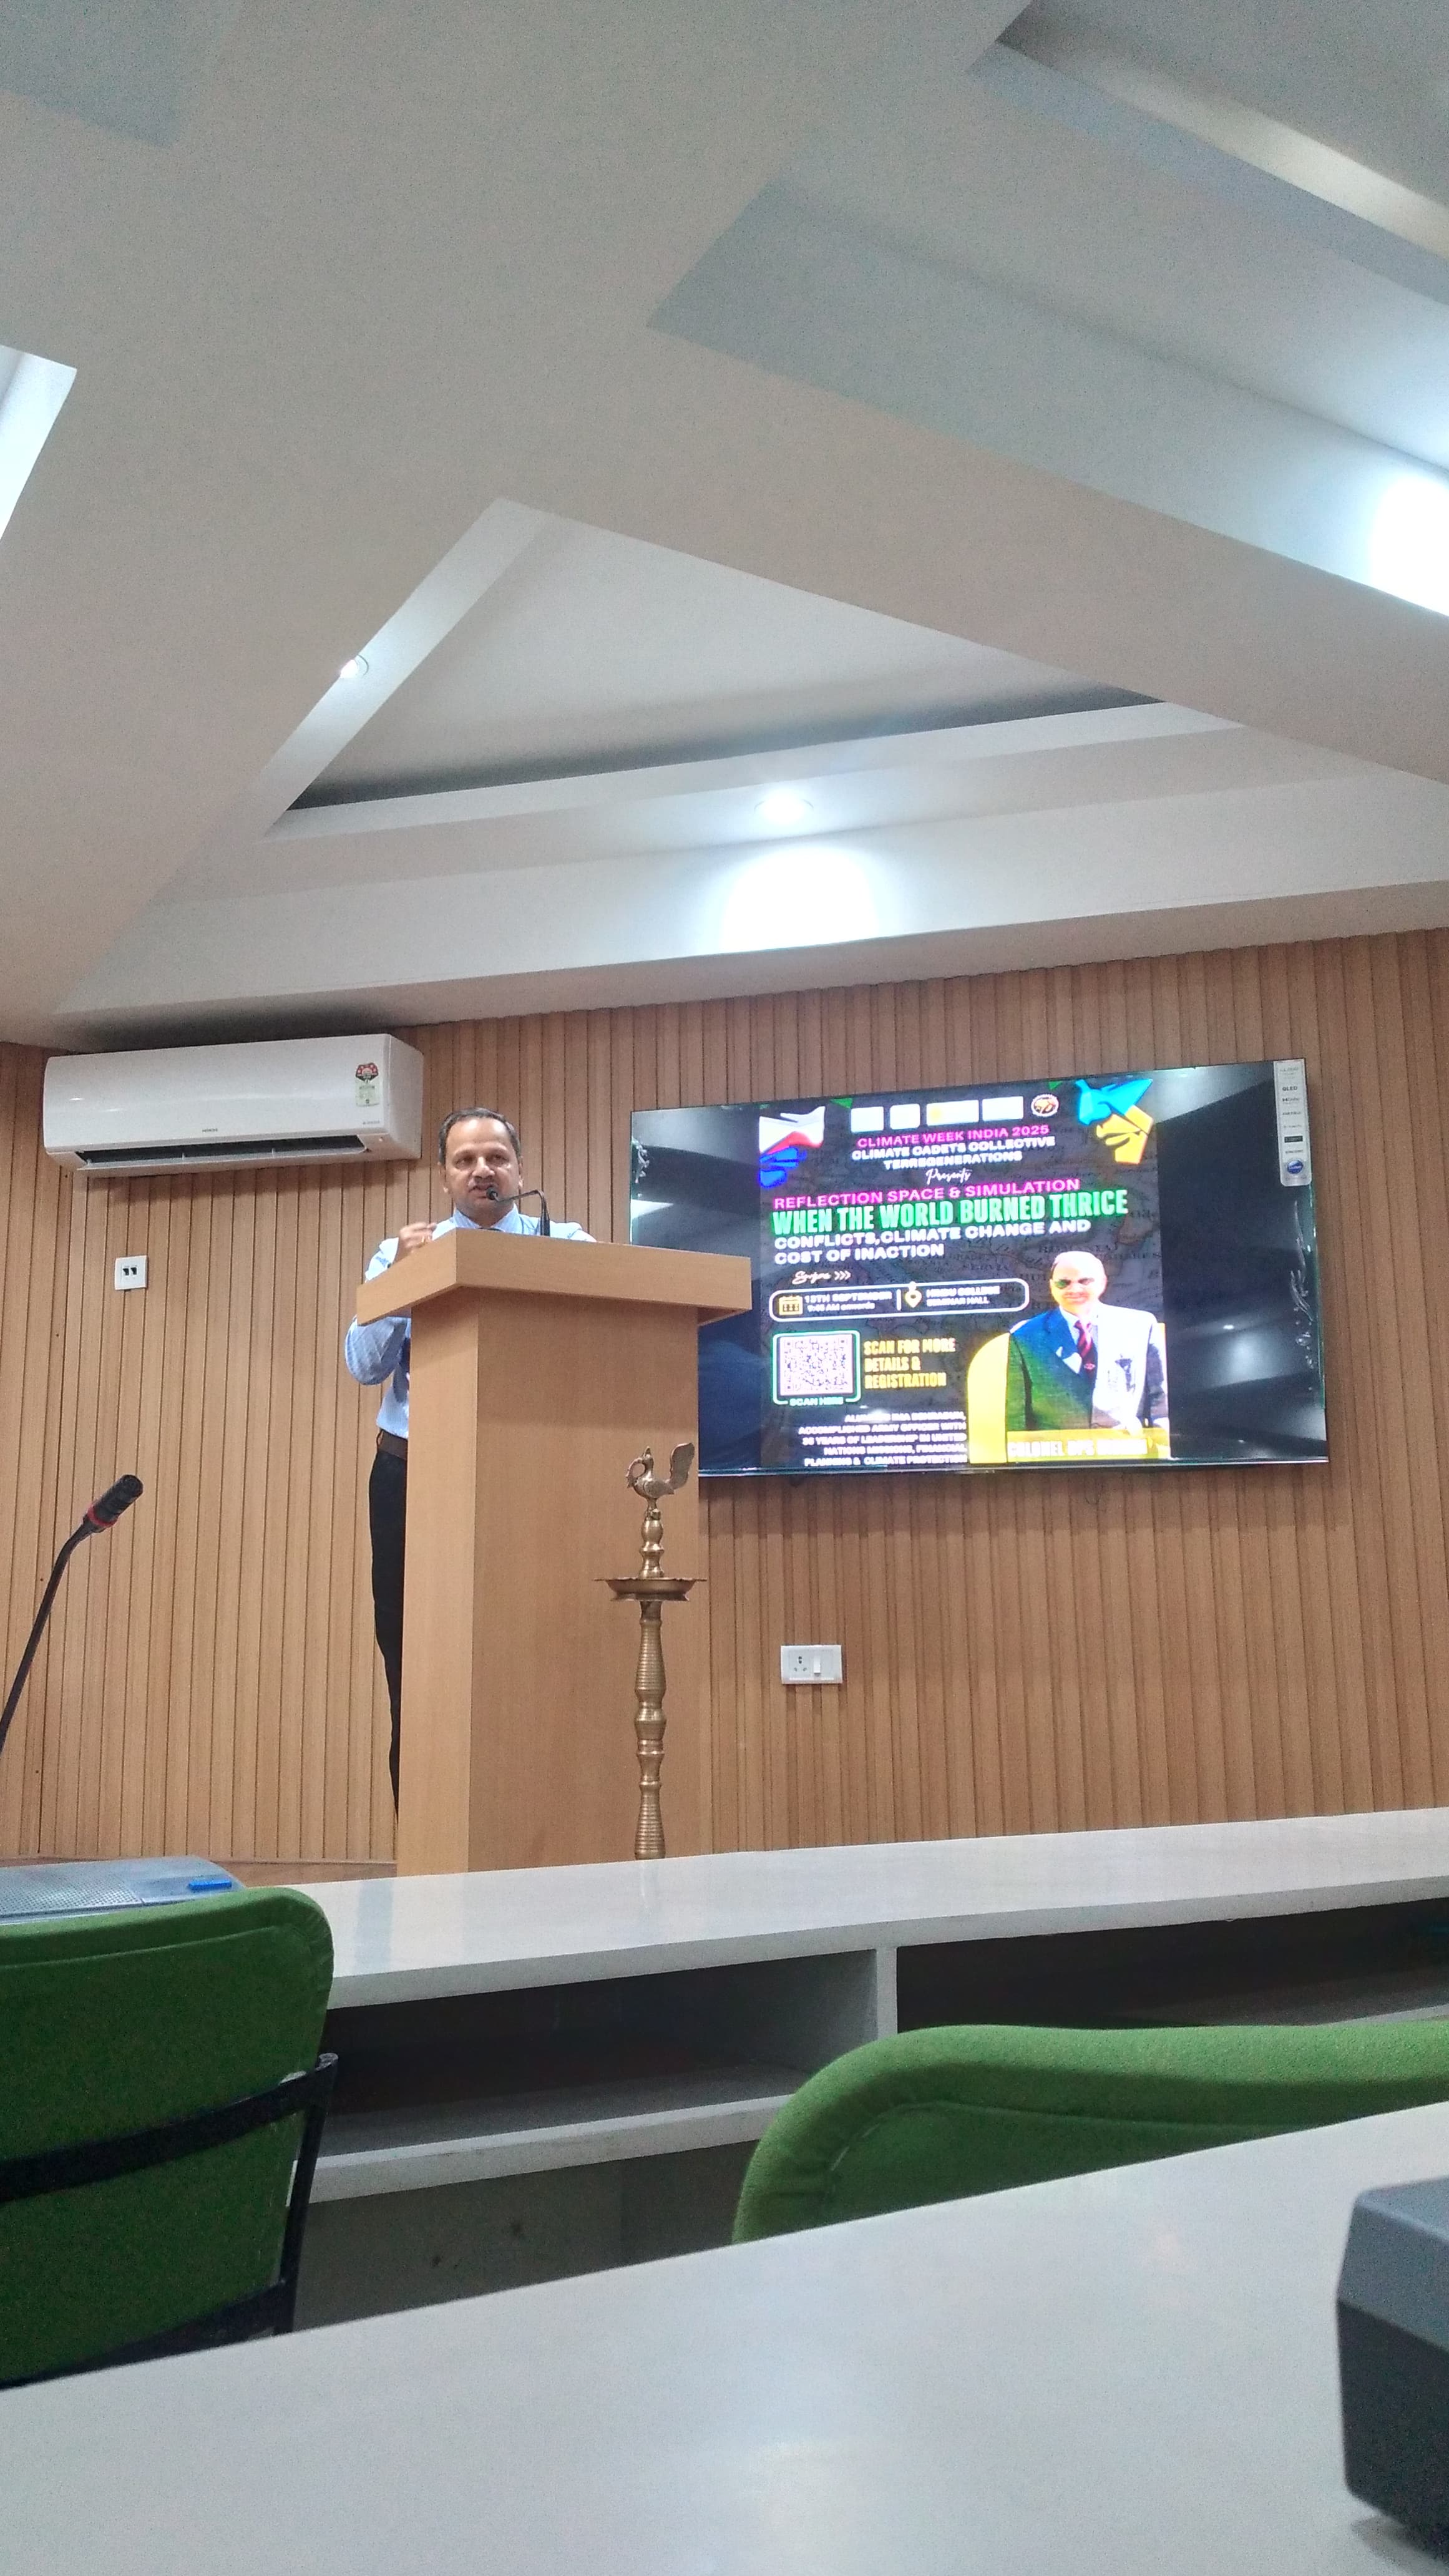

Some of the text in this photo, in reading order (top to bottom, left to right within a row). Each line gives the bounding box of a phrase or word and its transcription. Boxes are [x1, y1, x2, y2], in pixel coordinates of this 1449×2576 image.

[857, 1125, 1050, 1148] CLIMATE WEEK INDIA 2025
[851, 1136, 1056, 1161] CLIMATE CADETS COLLECTIVE
[925, 1168, 972, 1185] Presents
[774, 1178, 1080, 1210] REFLECTION SPACE & SIMULATION
[773, 1189, 1129, 1236] WHEN THE WORLD BURNED THRICE
[965, 1221, 1045, 1240] CHANGE
[1049, 1219, 1091, 1234] AND
[774, 1243, 945, 1265] COST OF INACTION
[863, 1338, 956, 1355] SCAN FOR MORE
[864, 1355, 922, 1373] DETAILS &
[864, 1372, 947, 1389] REGISTRATION
[789, 1398, 818, 1407] SCAN
